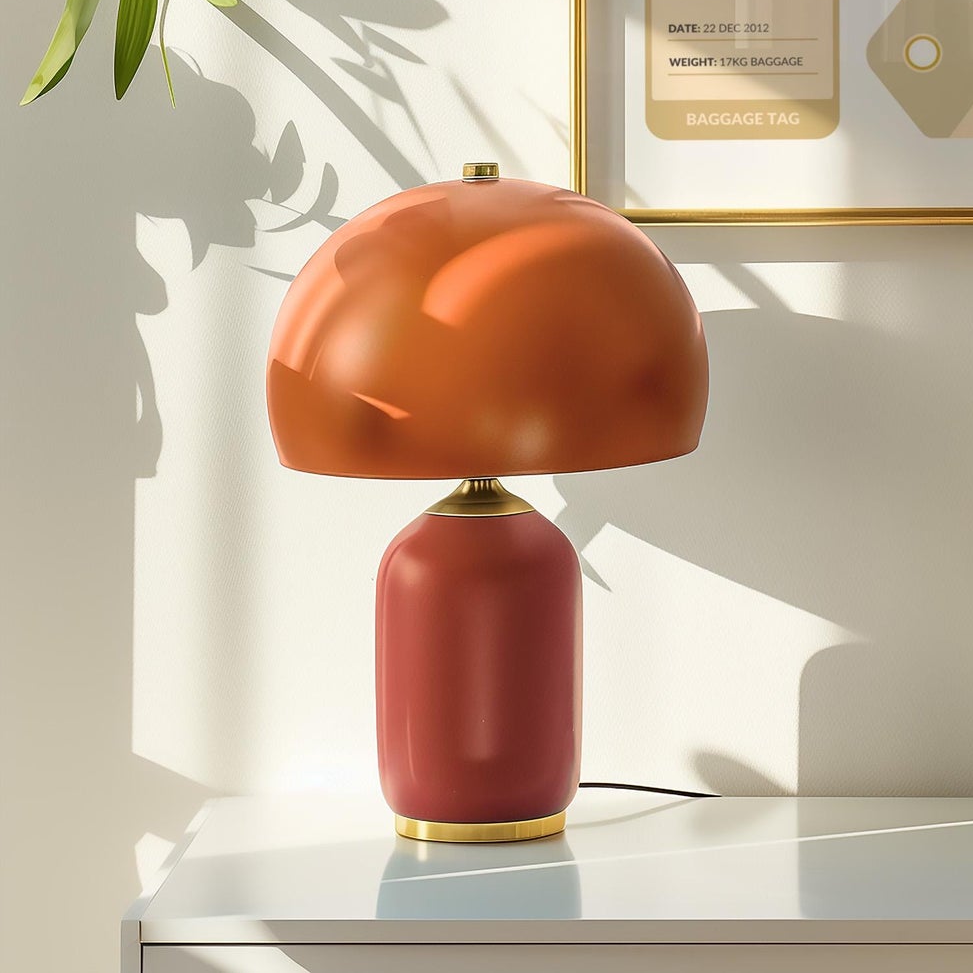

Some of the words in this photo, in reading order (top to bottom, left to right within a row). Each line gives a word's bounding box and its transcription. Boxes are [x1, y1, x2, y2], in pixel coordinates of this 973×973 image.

[668, 24, 700, 33] DATE:
[703, 24, 716, 33] 22
[719, 23, 740, 33] DEC
[744, 23, 769, 33] 2012
[669, 57, 717, 67] WEIGHT:
[720, 57, 747, 66] 17KG
[751, 57, 803, 66] BAGGAGE
[686, 112, 764, 125] BAGGAGE
[767, 112, 800, 125] TAG
